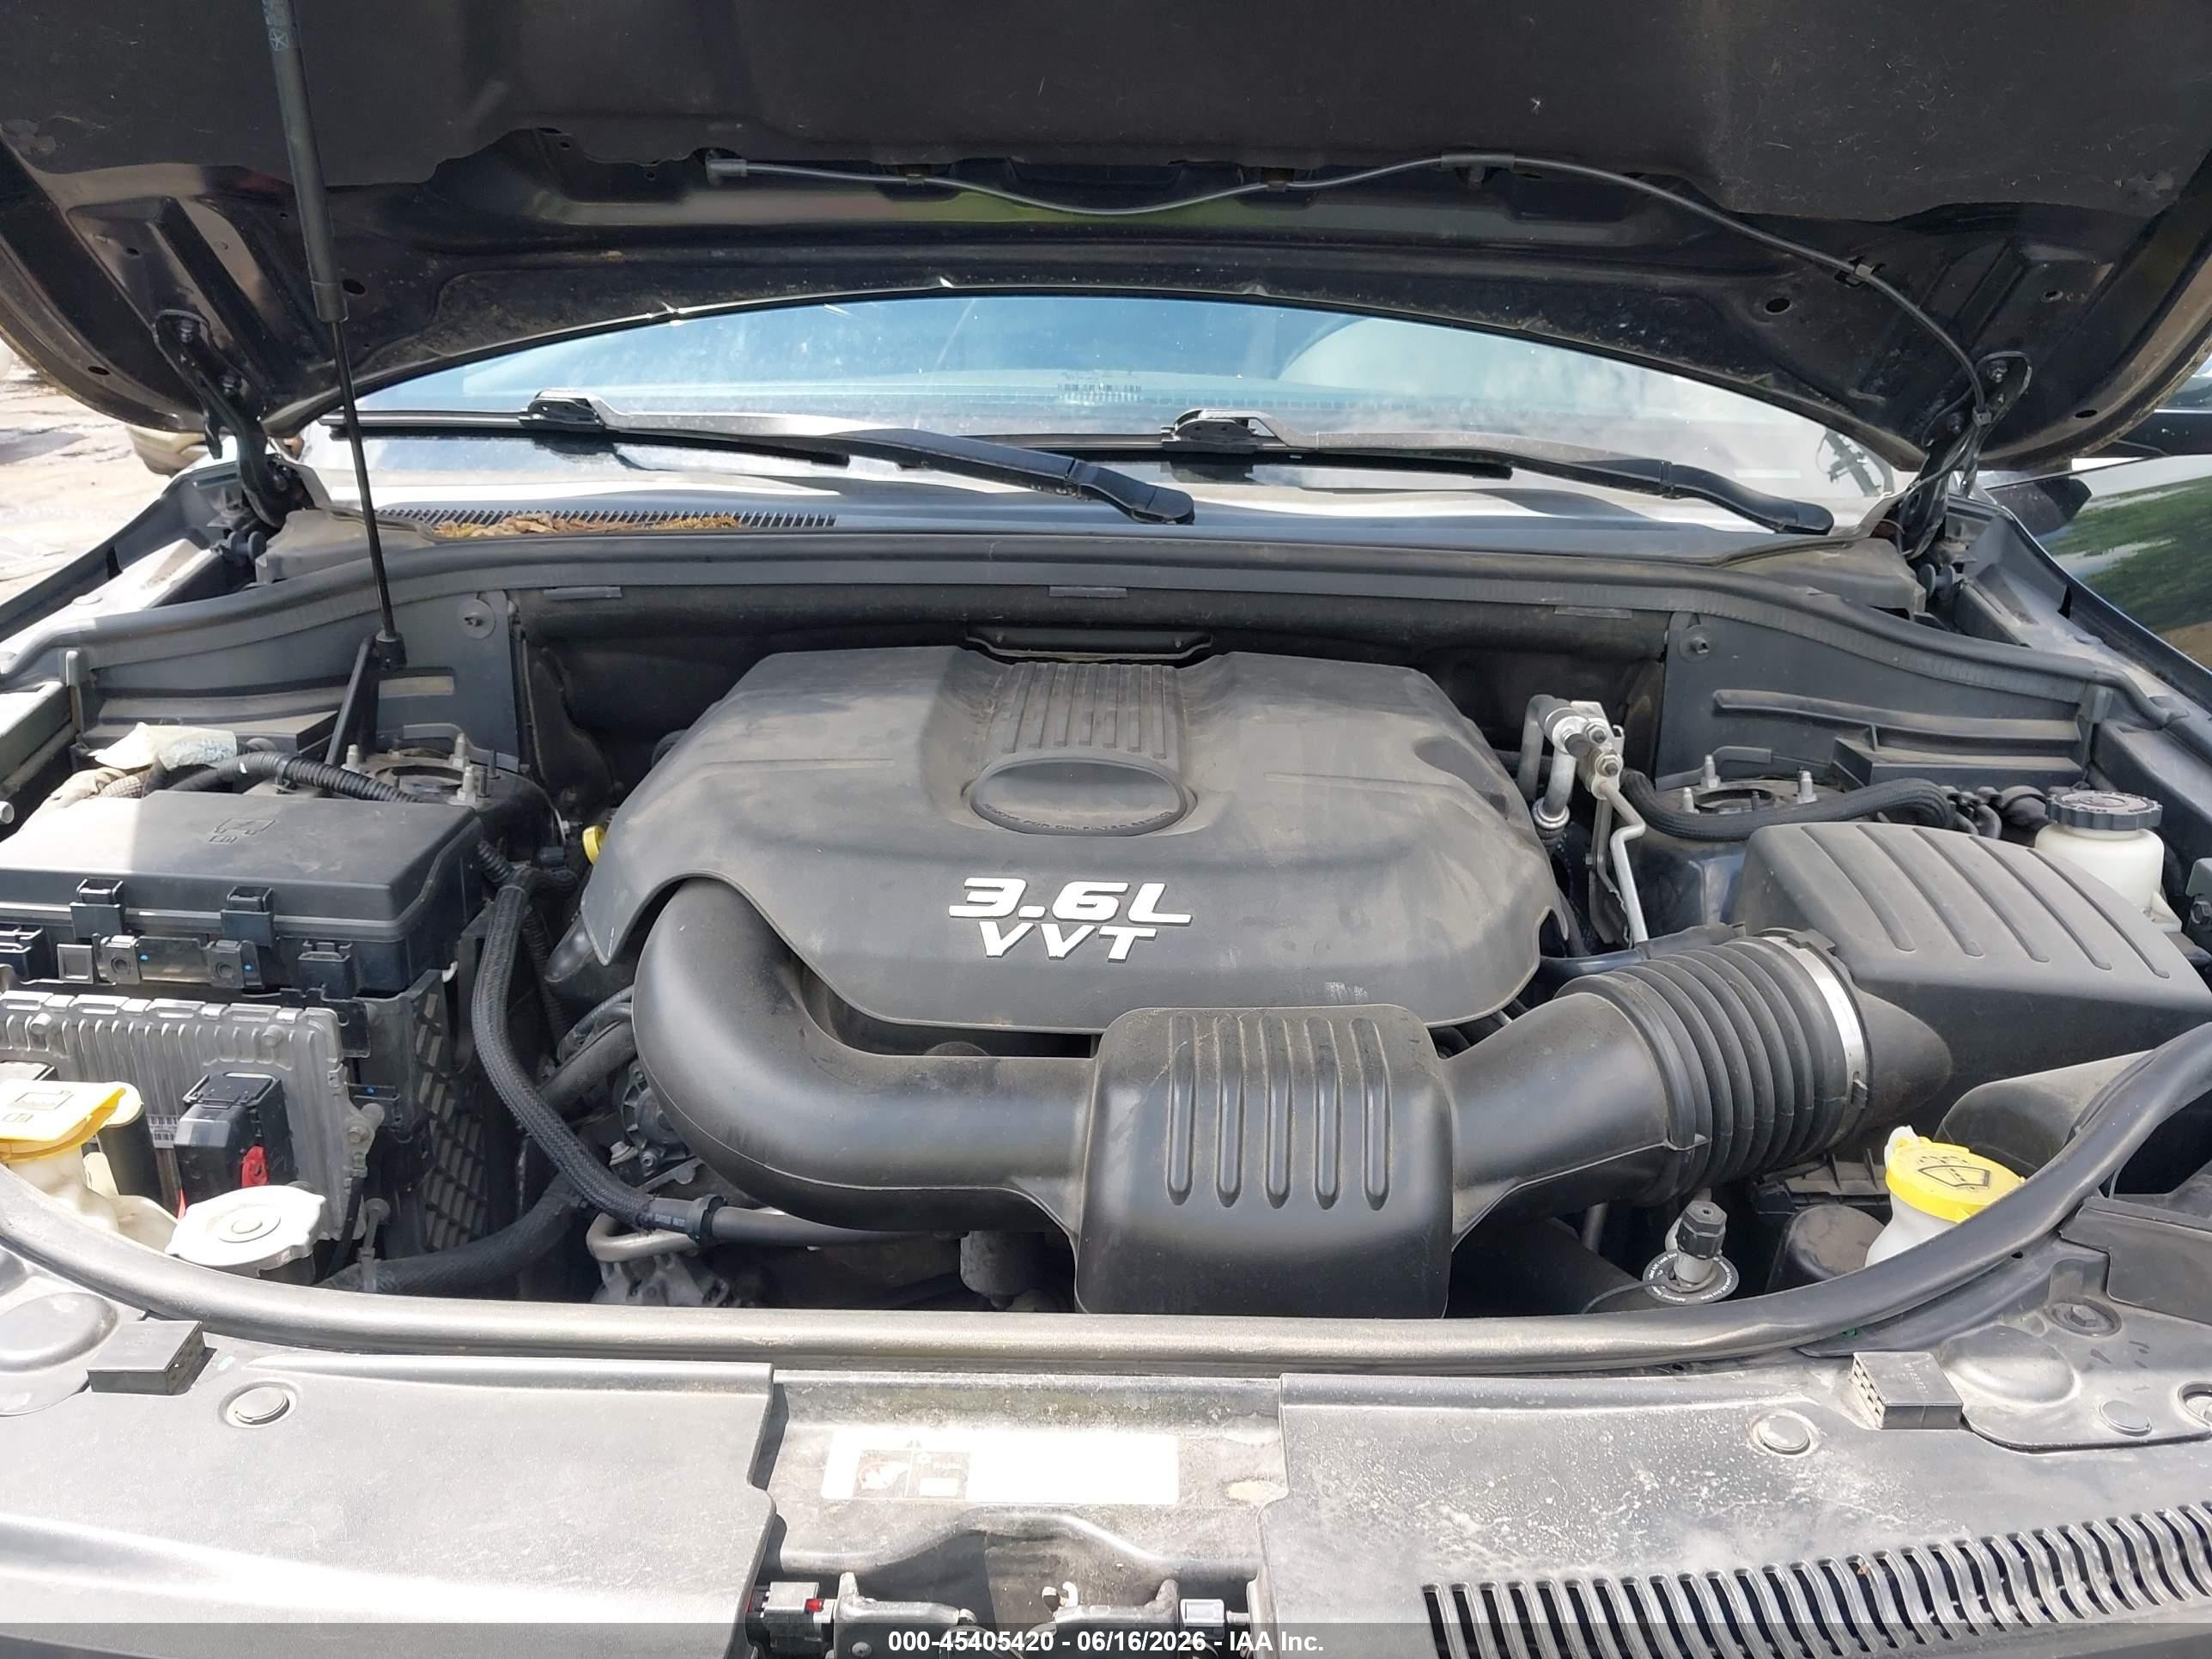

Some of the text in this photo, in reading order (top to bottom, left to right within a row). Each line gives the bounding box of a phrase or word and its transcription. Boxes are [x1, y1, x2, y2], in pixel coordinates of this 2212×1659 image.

[1023, 819, 1050, 828] FOR
[948, 877, 1193, 926] 3.6L
[978, 920, 1158, 963] VVT
